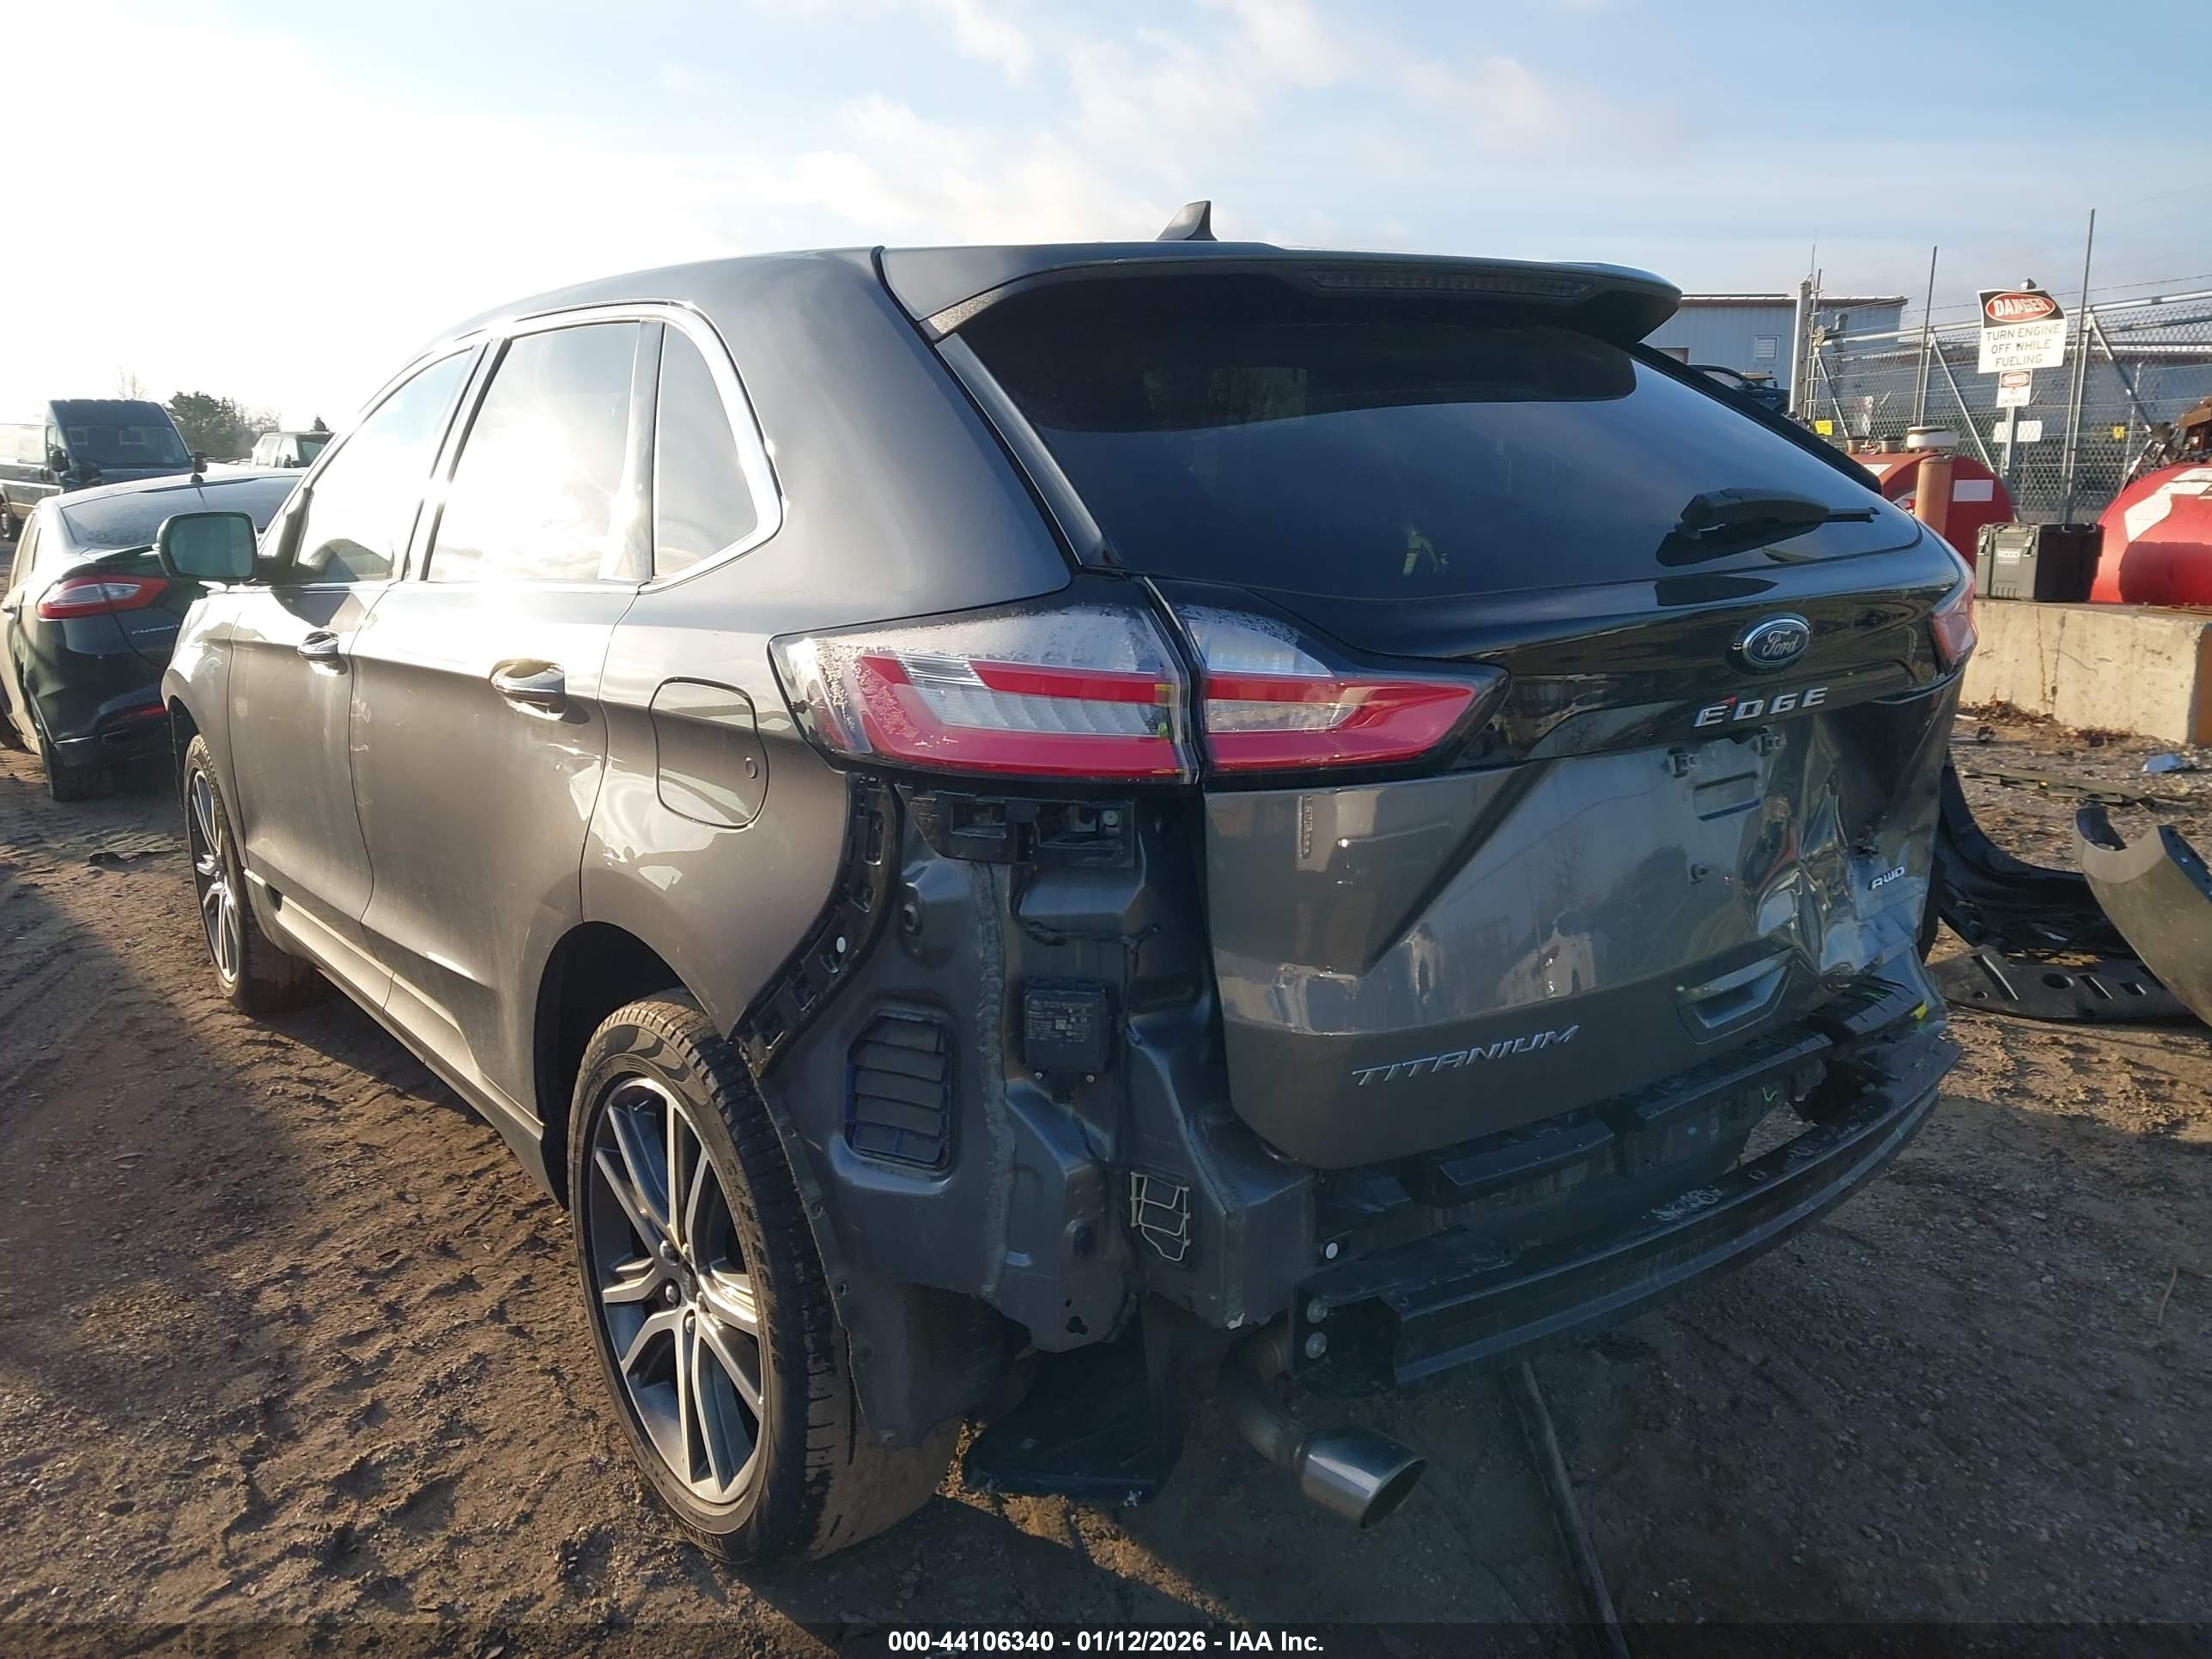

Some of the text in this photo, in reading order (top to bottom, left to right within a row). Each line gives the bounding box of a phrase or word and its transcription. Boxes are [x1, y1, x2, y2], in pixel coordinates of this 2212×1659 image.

[1993, 298, 2051, 317] DANGER
[1986, 324, 2062, 342] TURN ENGINE
[1990, 338, 2052, 355] OFF WHILE
[1995, 354, 2043, 368] FUELING
[1761, 629, 1800, 658] Ford
[1693, 686, 1830, 728] EDGE
[1869, 866, 1905, 890] AWD
[1351, 1024, 1580, 1086] TITANIUM
